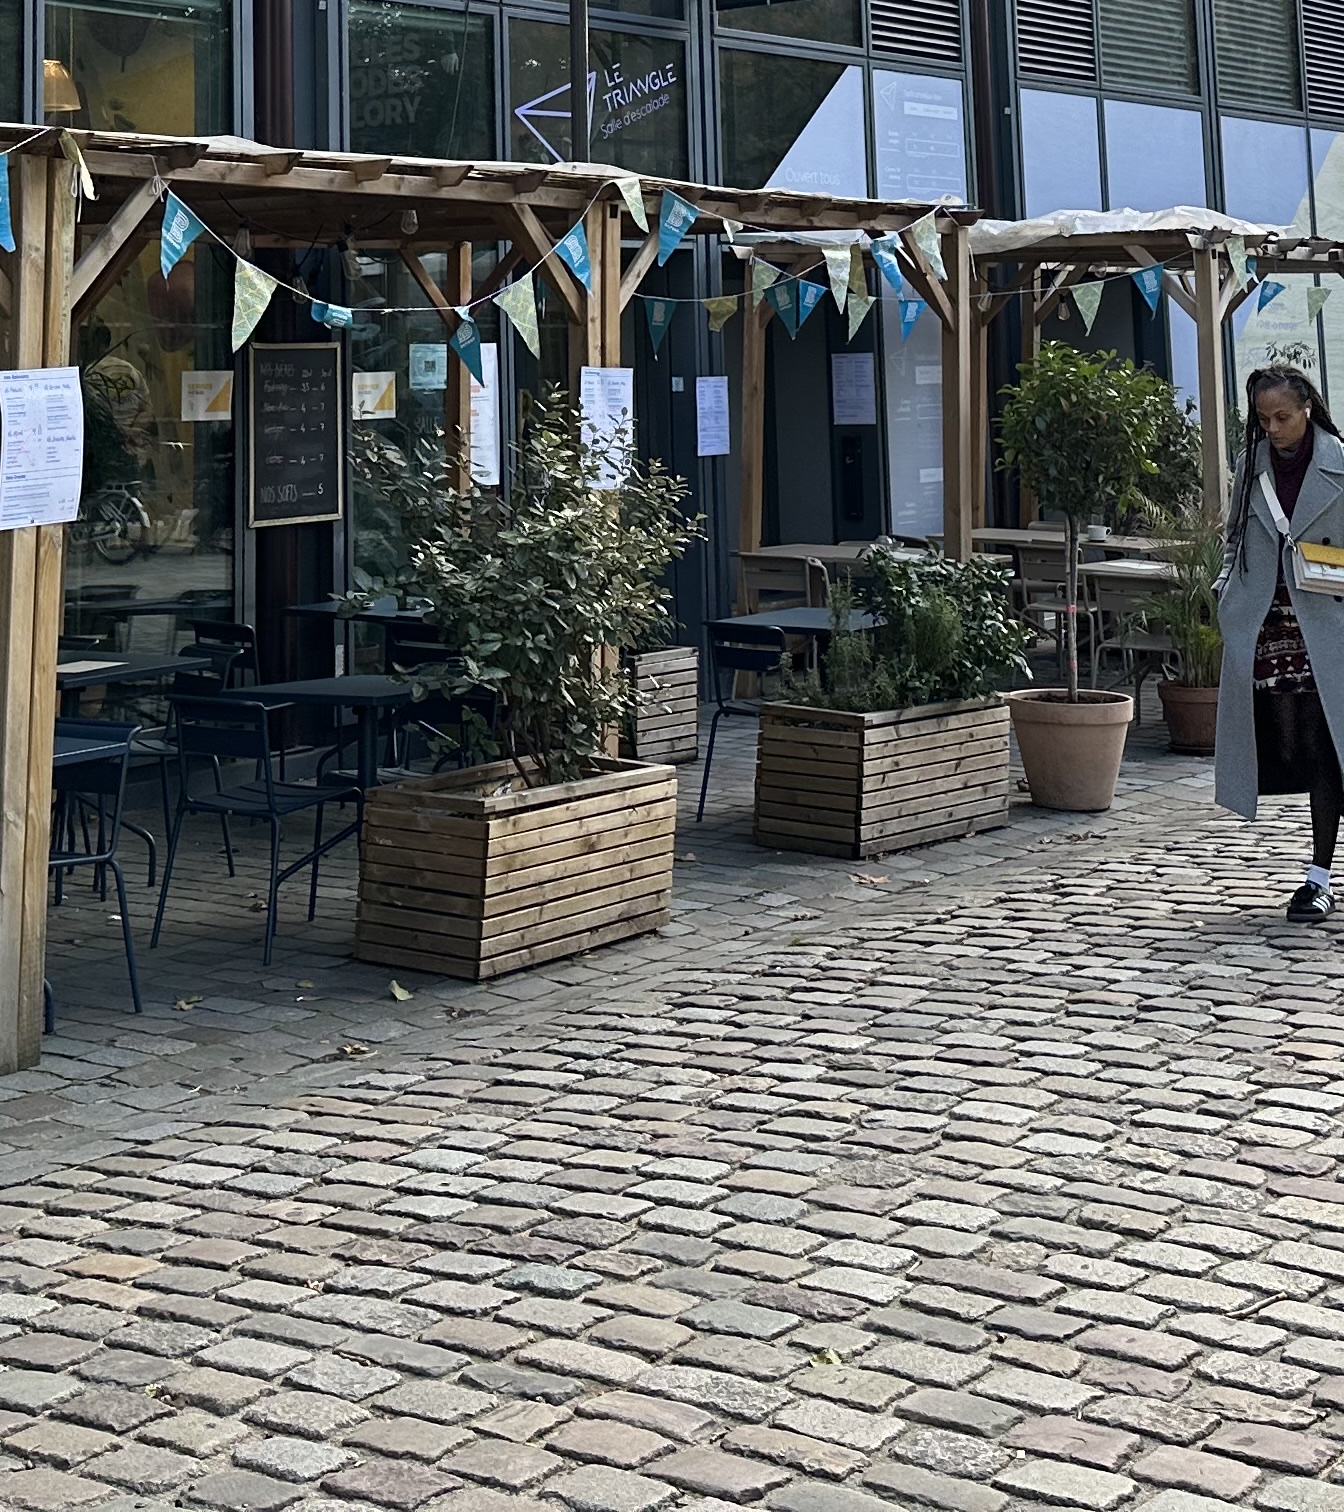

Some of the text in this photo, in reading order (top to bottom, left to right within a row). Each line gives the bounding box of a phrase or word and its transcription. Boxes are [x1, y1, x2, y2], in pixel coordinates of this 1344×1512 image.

[602, 63, 677, 113] TRIANGLE
[603, 63, 624, 88] LE
[350, 96, 422, 128] LORY
